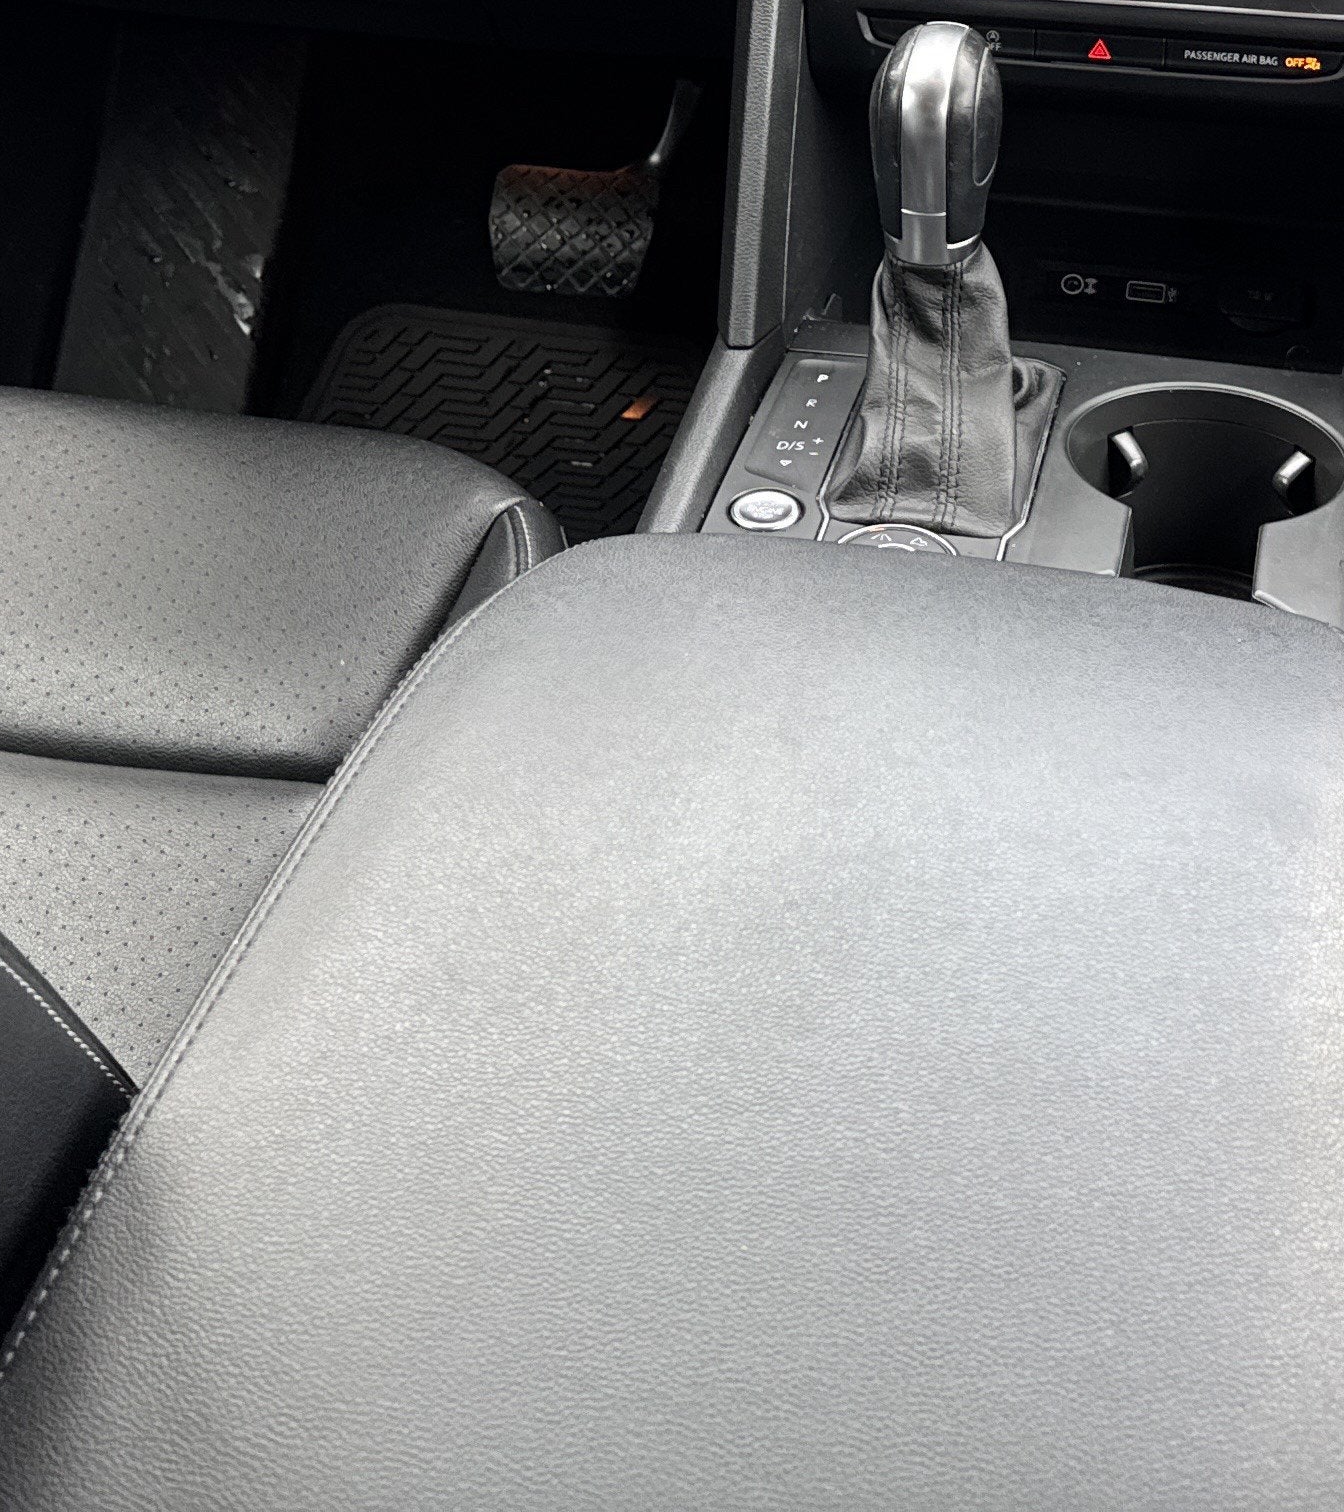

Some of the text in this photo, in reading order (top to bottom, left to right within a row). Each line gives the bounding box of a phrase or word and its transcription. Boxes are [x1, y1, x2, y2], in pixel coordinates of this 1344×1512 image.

[1183, 49, 1305, 68] PASSENGER AIR BAG OFF
[816, 373, 829, 383] P
[806, 398, 818, 408] R
[793, 420, 809, 430] N
[776, 440, 806, 451] D/S
